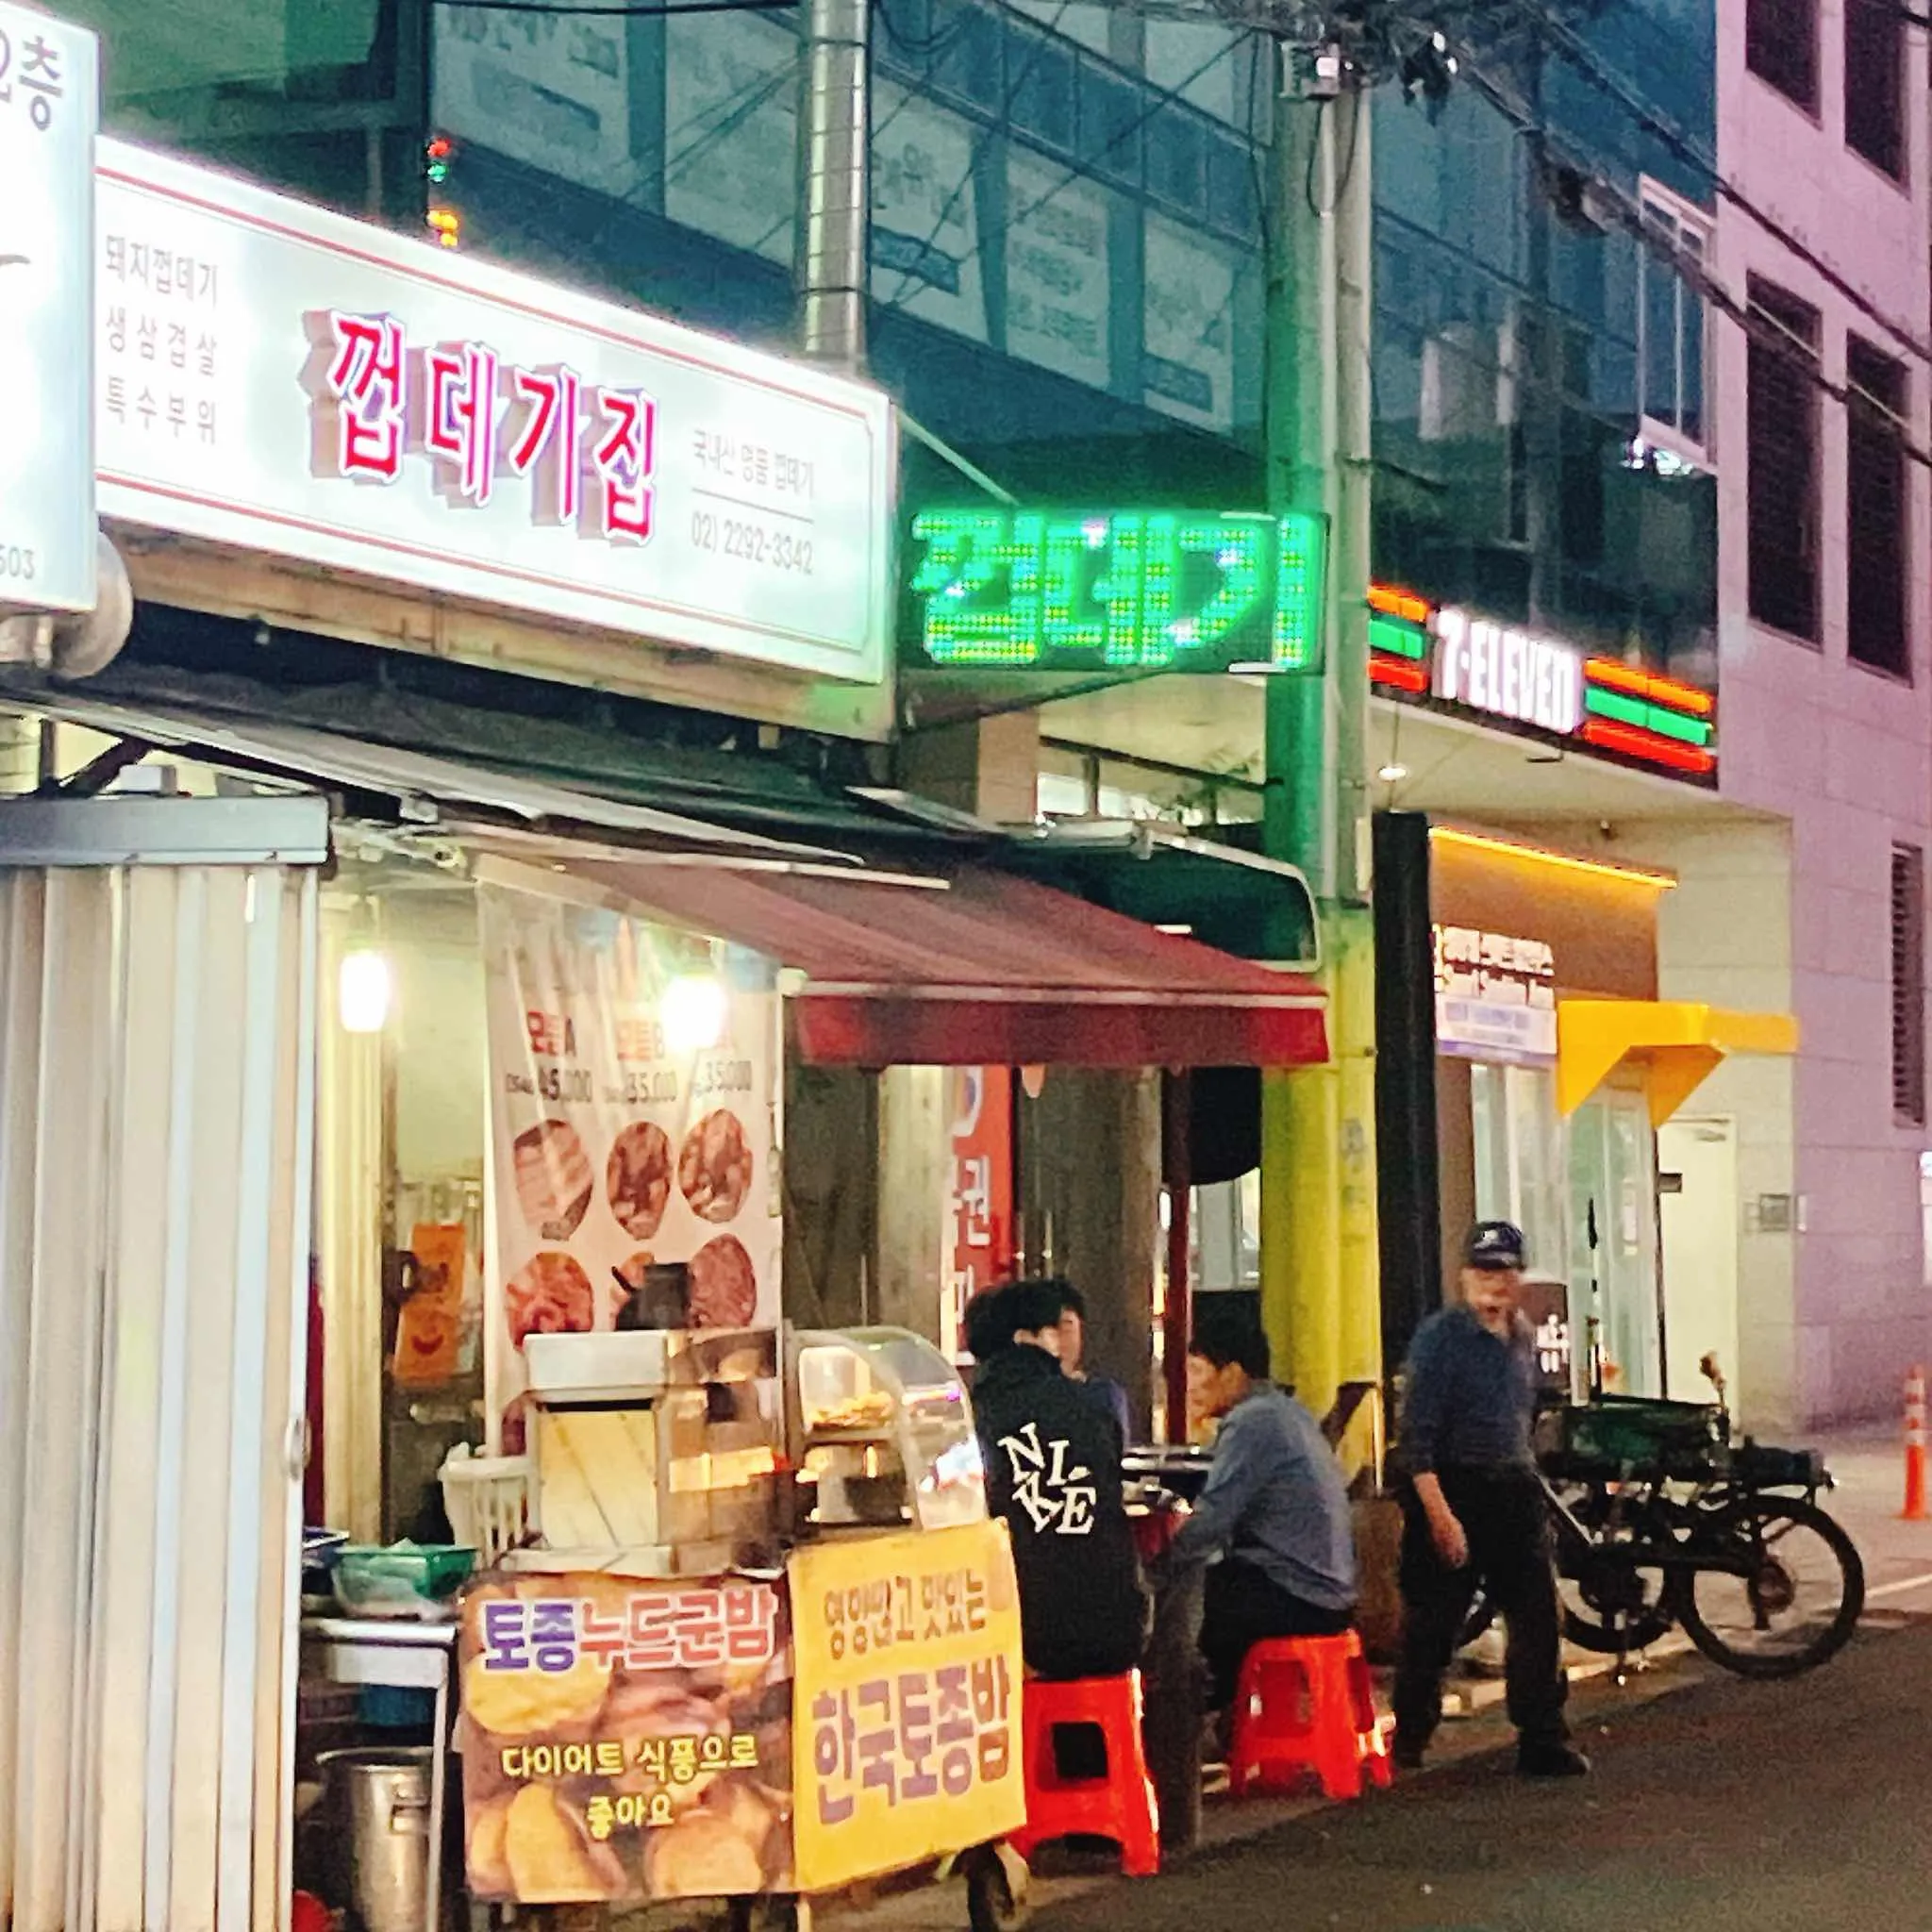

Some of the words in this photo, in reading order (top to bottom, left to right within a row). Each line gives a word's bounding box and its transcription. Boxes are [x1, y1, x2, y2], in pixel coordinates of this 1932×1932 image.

[0, 28, 64, 131] 층
[330, 311, 657, 544] 껍데기집
[912, 510, 1318, 666] 껍데기
[1436, 608, 1578, 734] 7-ELEVEN
[502, 1742, 624, 1778] 다이어트
[637, 1733, 759, 1782] 식품으로
[587, 1793, 675, 1840] 좋아요
